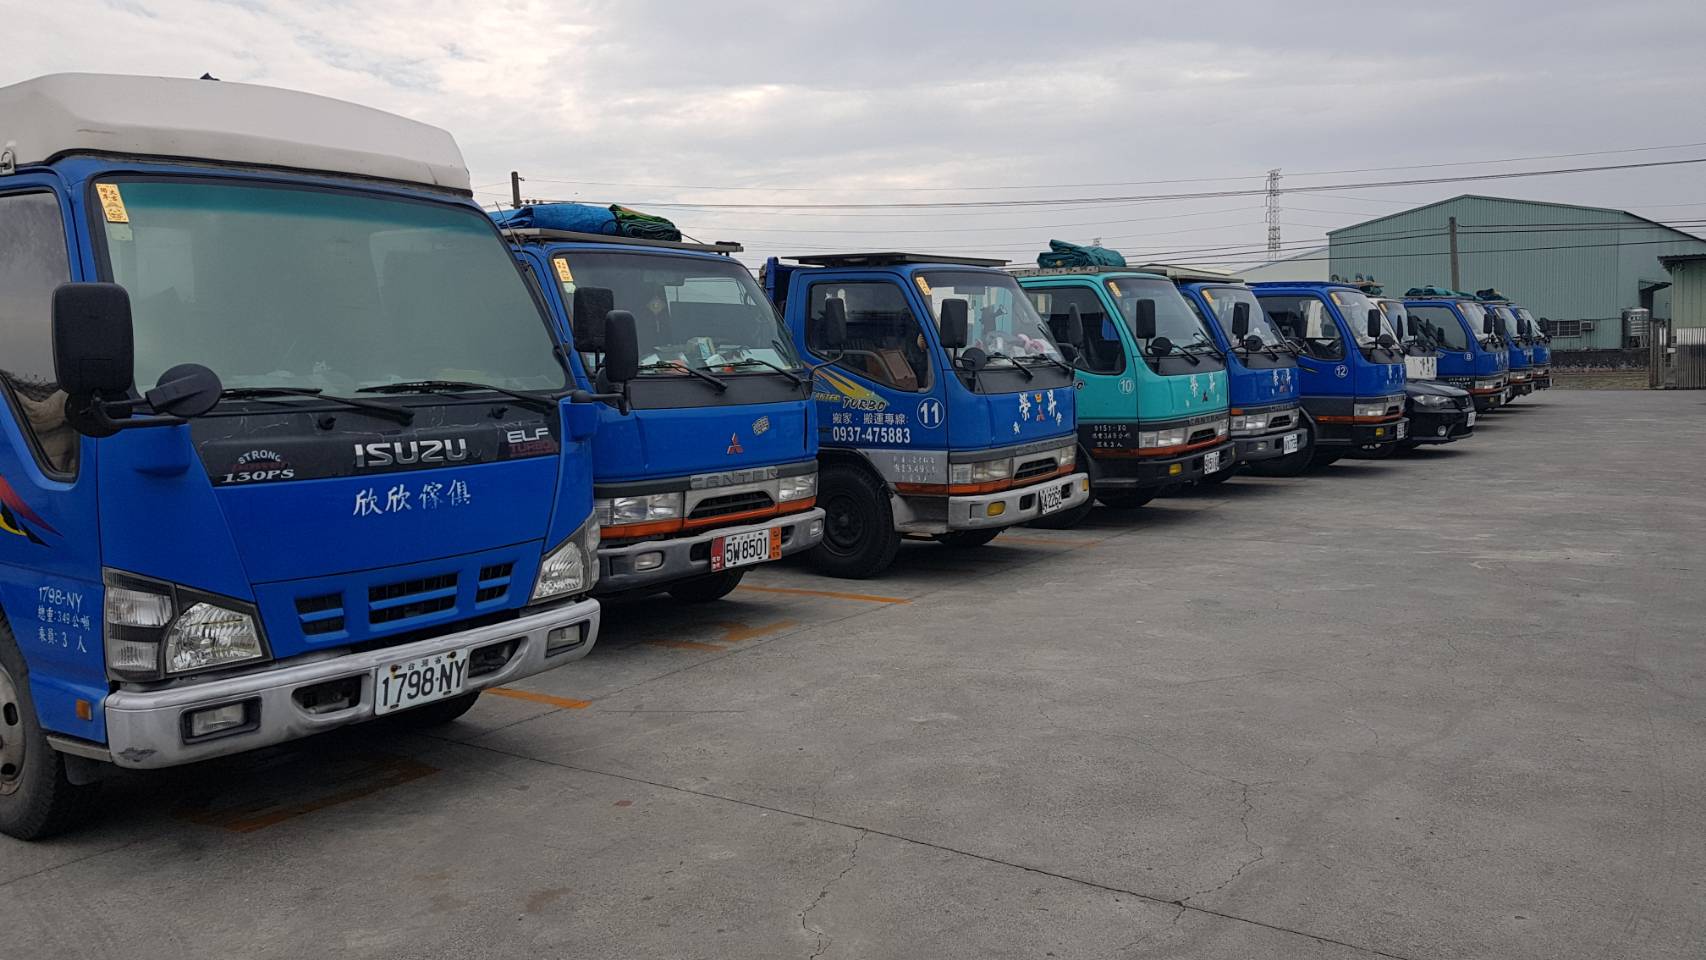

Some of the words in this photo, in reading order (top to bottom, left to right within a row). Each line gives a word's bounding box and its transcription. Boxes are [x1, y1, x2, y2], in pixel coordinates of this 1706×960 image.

[1120, 379, 1132, 392] 10
[842, 396, 887, 412] TURBO
[920, 402, 940, 424] 11
[506, 427, 549, 444] ELF
[832, 426, 910, 443] 0937-475883
[238, 449, 281, 464] STRONG
[354, 438, 468, 467] ISUZU
[221, 469, 295, 483] 130PS
[39, 586, 83, 613] 1798-NY
[77, 635, 87, 653] 人
